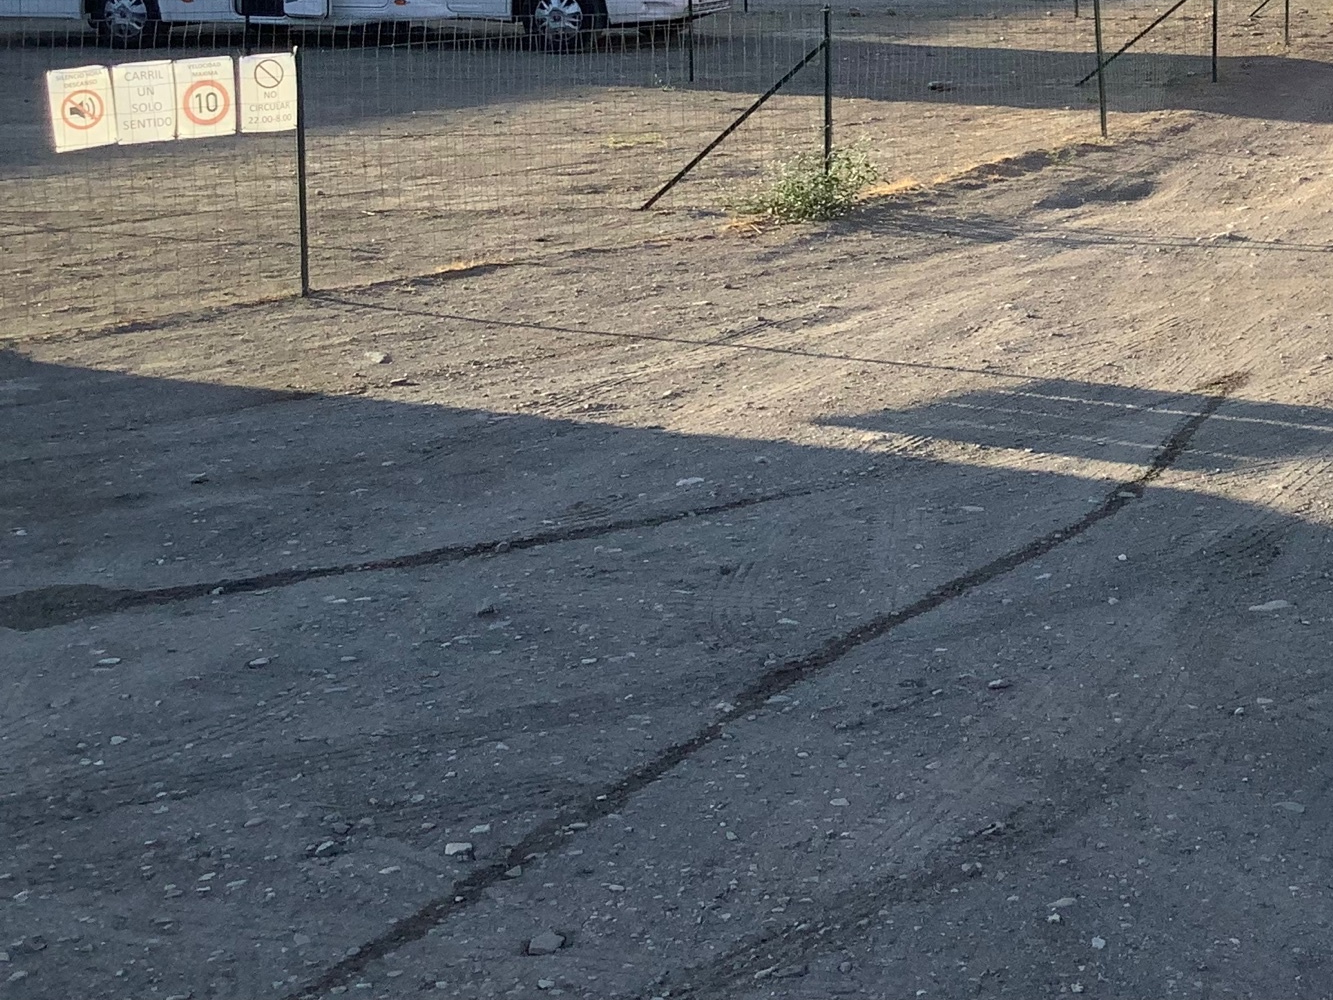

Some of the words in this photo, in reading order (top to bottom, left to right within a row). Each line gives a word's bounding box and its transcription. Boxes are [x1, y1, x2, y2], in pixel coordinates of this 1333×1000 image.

[124, 71, 163, 81] CARRIL
[137, 87, 154, 96] UN
[264, 91, 277, 99] NO
[132, 102, 162, 113] SOLO
[195, 92, 218, 113] 10
[250, 102, 290, 112] CIRCULAR
[123, 117, 172, 130] SENTIDO
